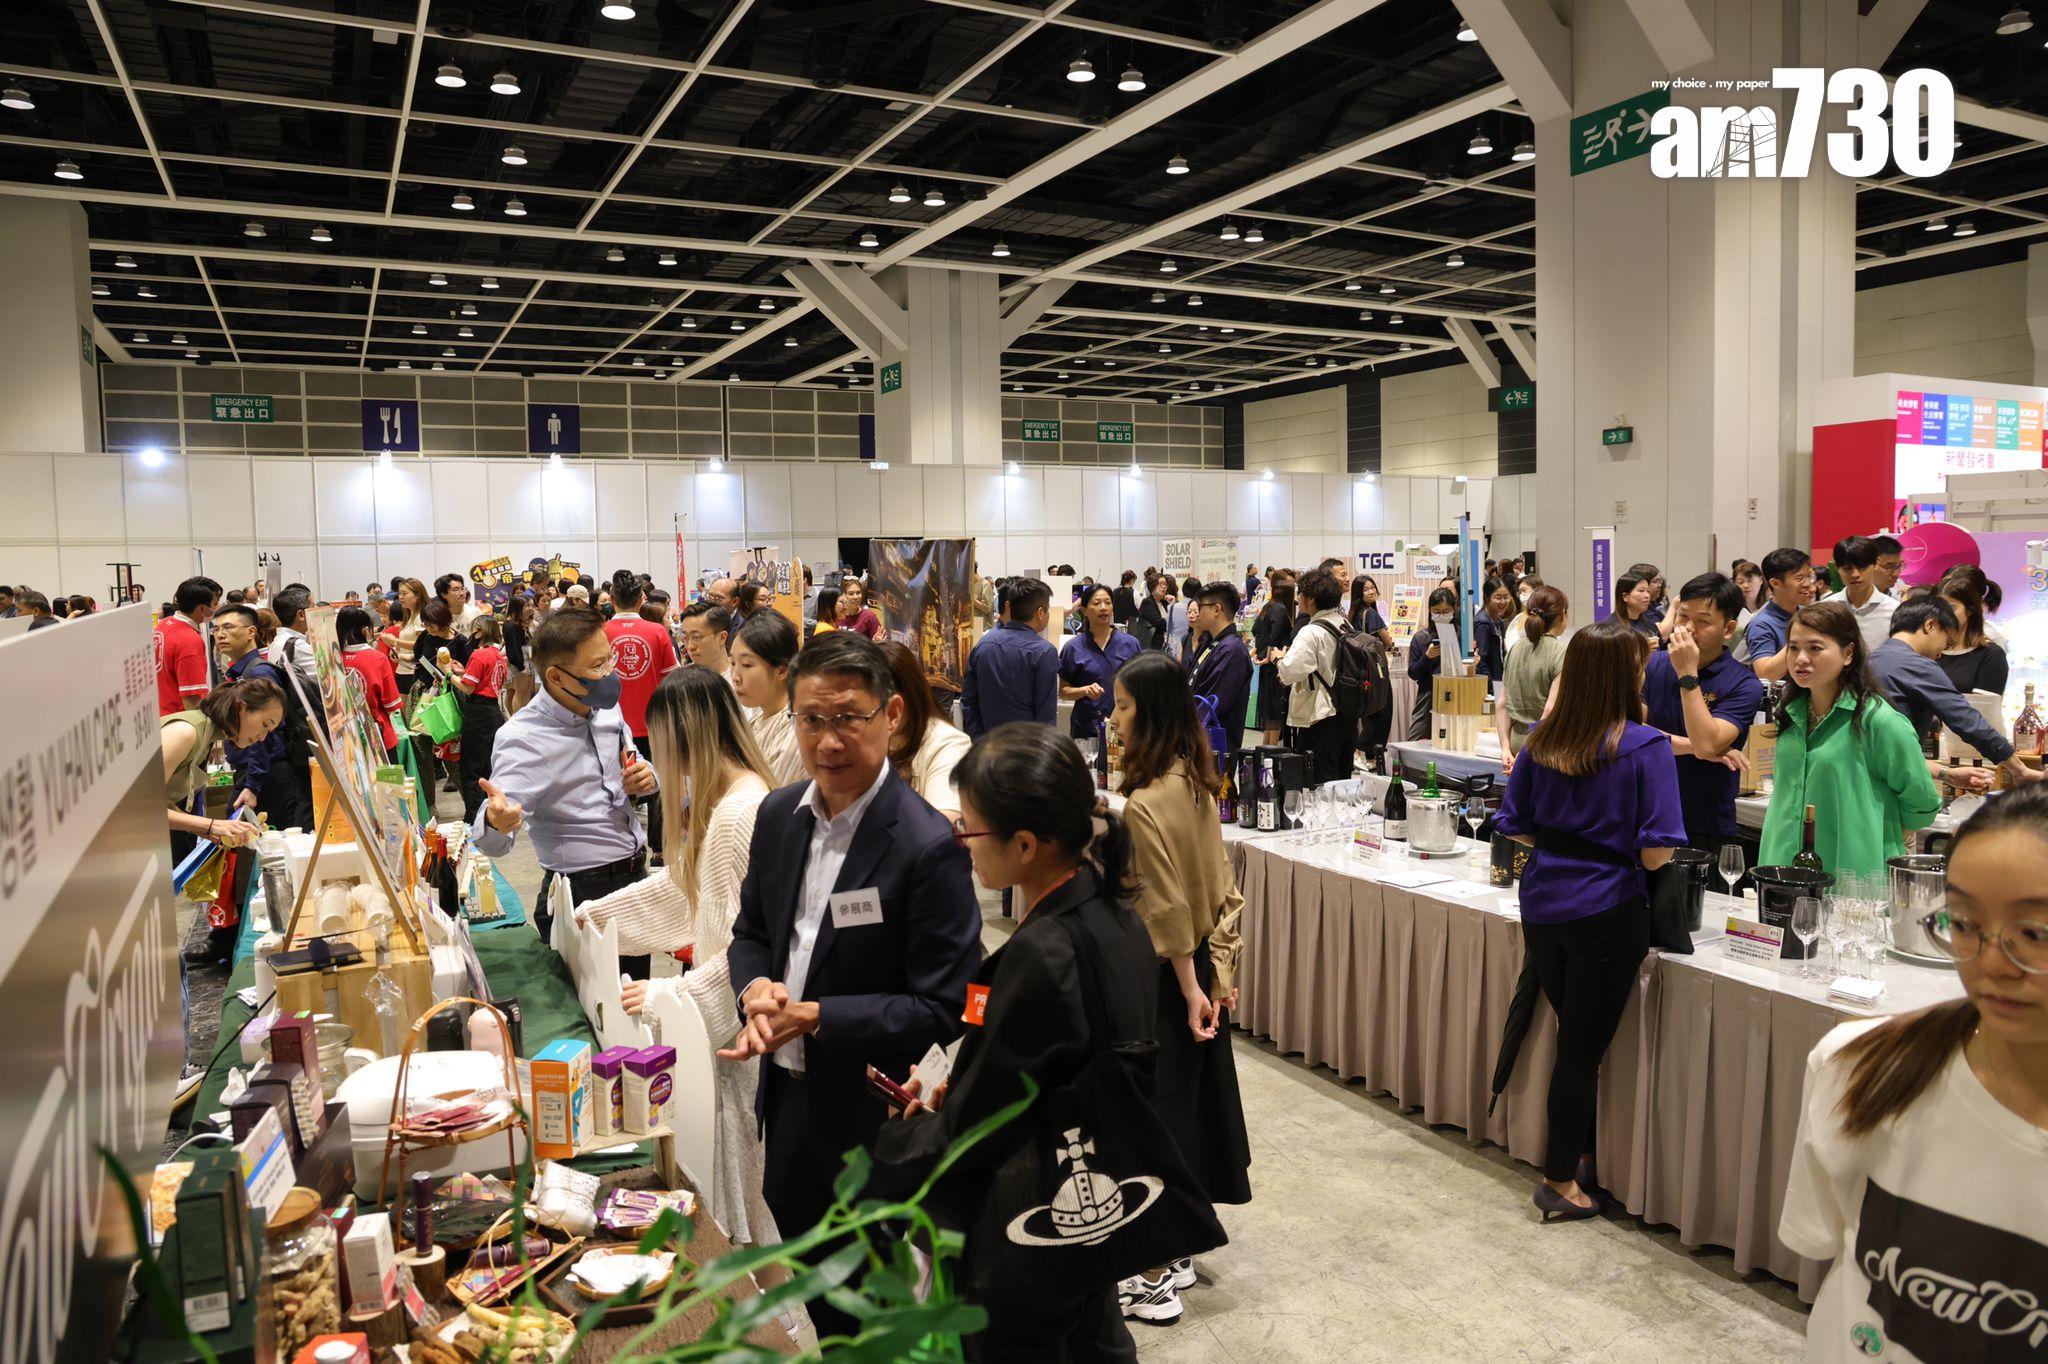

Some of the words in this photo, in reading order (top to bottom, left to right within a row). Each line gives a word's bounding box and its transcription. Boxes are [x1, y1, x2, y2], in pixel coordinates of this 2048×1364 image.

[215, 397, 254, 406] EMERGENCY
[255, 399, 269, 407] EXIT
[215, 406, 269, 419] 緊急出口
[1025, 429, 1058, 439] 緊急出口
[1099, 432, 1131, 441] 緊急出口
[1165, 543, 1191, 556] SOLAR
[1165, 556, 1192, 570] SHIELD
[1359, 553, 1394, 569] TGC
[839, 901, 873, 916] 參展商
